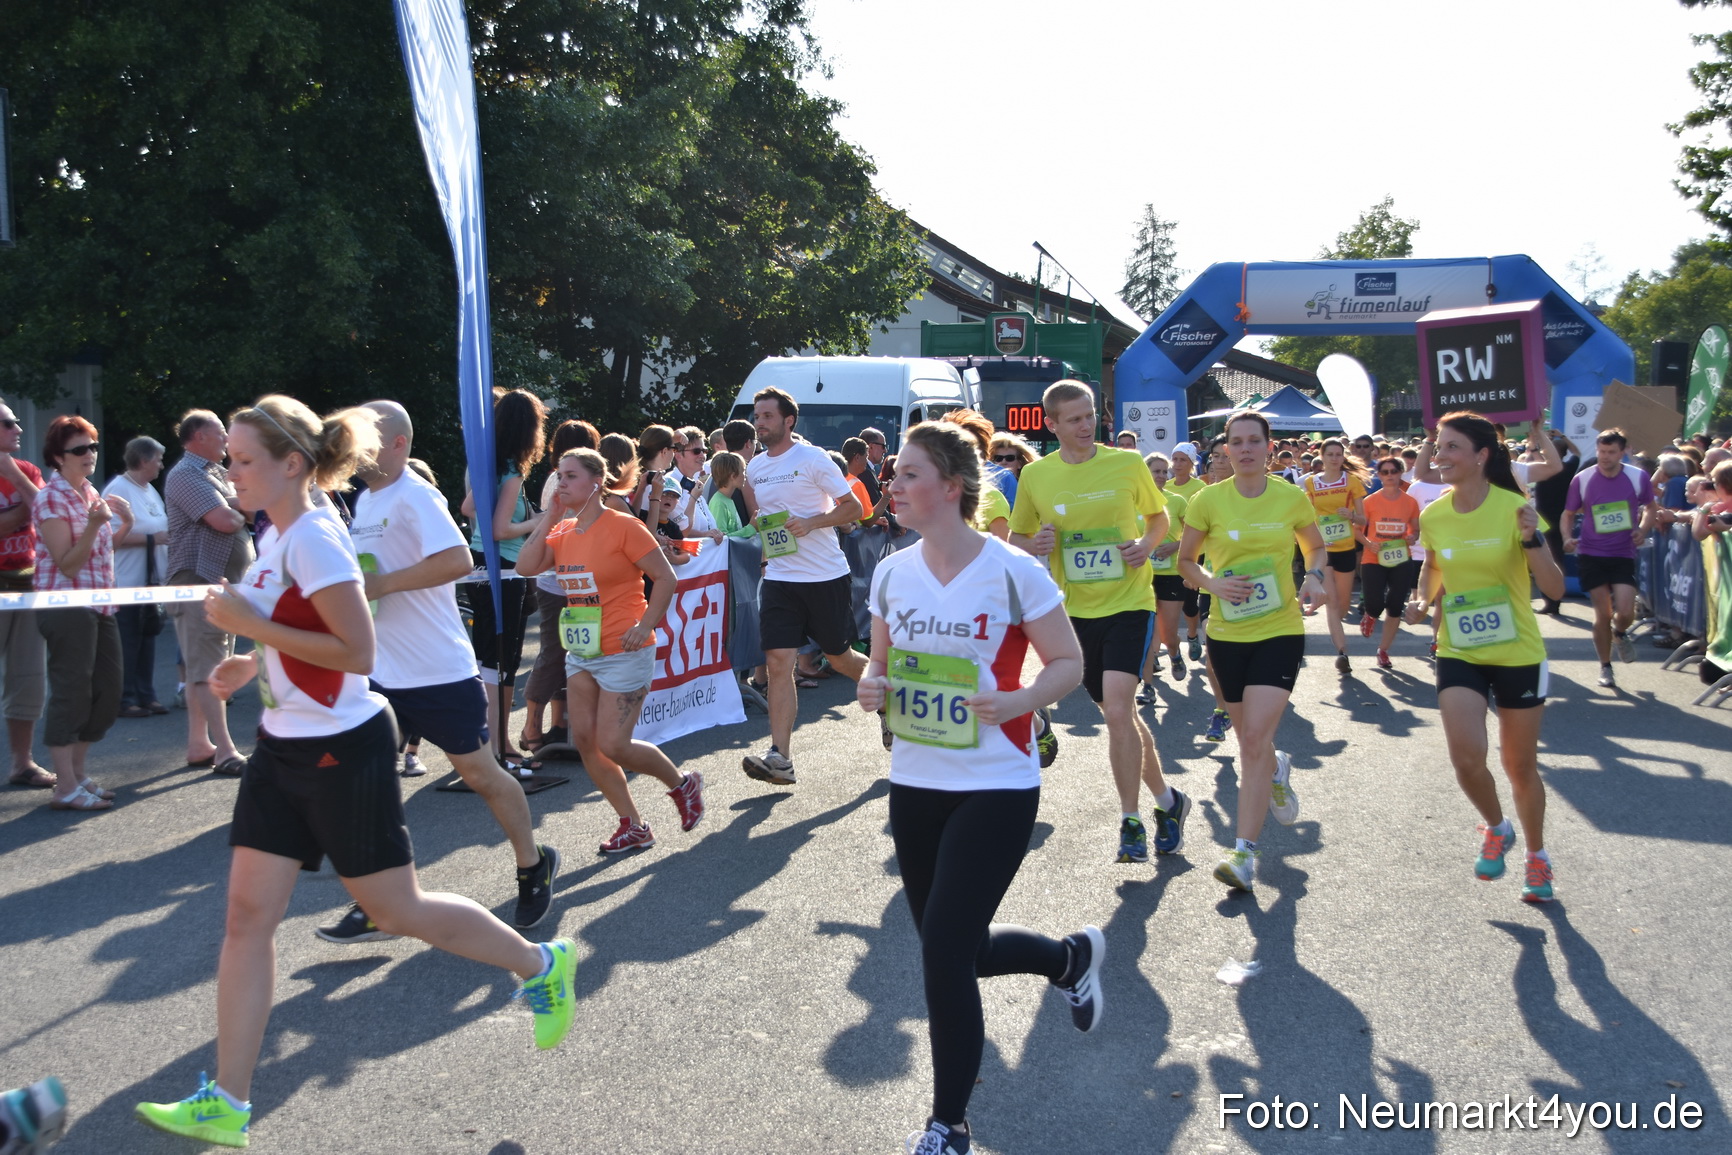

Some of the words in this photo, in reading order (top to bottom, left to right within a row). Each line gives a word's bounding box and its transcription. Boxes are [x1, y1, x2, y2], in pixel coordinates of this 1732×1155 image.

[1363, 280, 1395, 288] Fischer
[1339, 295, 1432, 313] firmenlauf
[1169, 331, 1218, 341] Fischer
[1496, 333, 1513, 345] NM
[1436, 345, 1494, 385] RW
[1440, 389, 1517, 405] RAUMWERK
[1601, 512, 1624, 525] 295
[1325, 523, 1345, 536] 872
[767, 529, 788, 546] 526
[1074, 549, 1112, 569] 674
[1383, 549, 1403, 561] 618
[567, 564, 585, 572] Jahre
[568, 593, 601, 606] umarkt
[1458, 611, 1501, 634] 669
[566, 627, 591, 645] 613
[895, 686, 969, 725] 1516
[910, 723, 927, 733] Franzi
[927, 726, 948, 736] Langer
